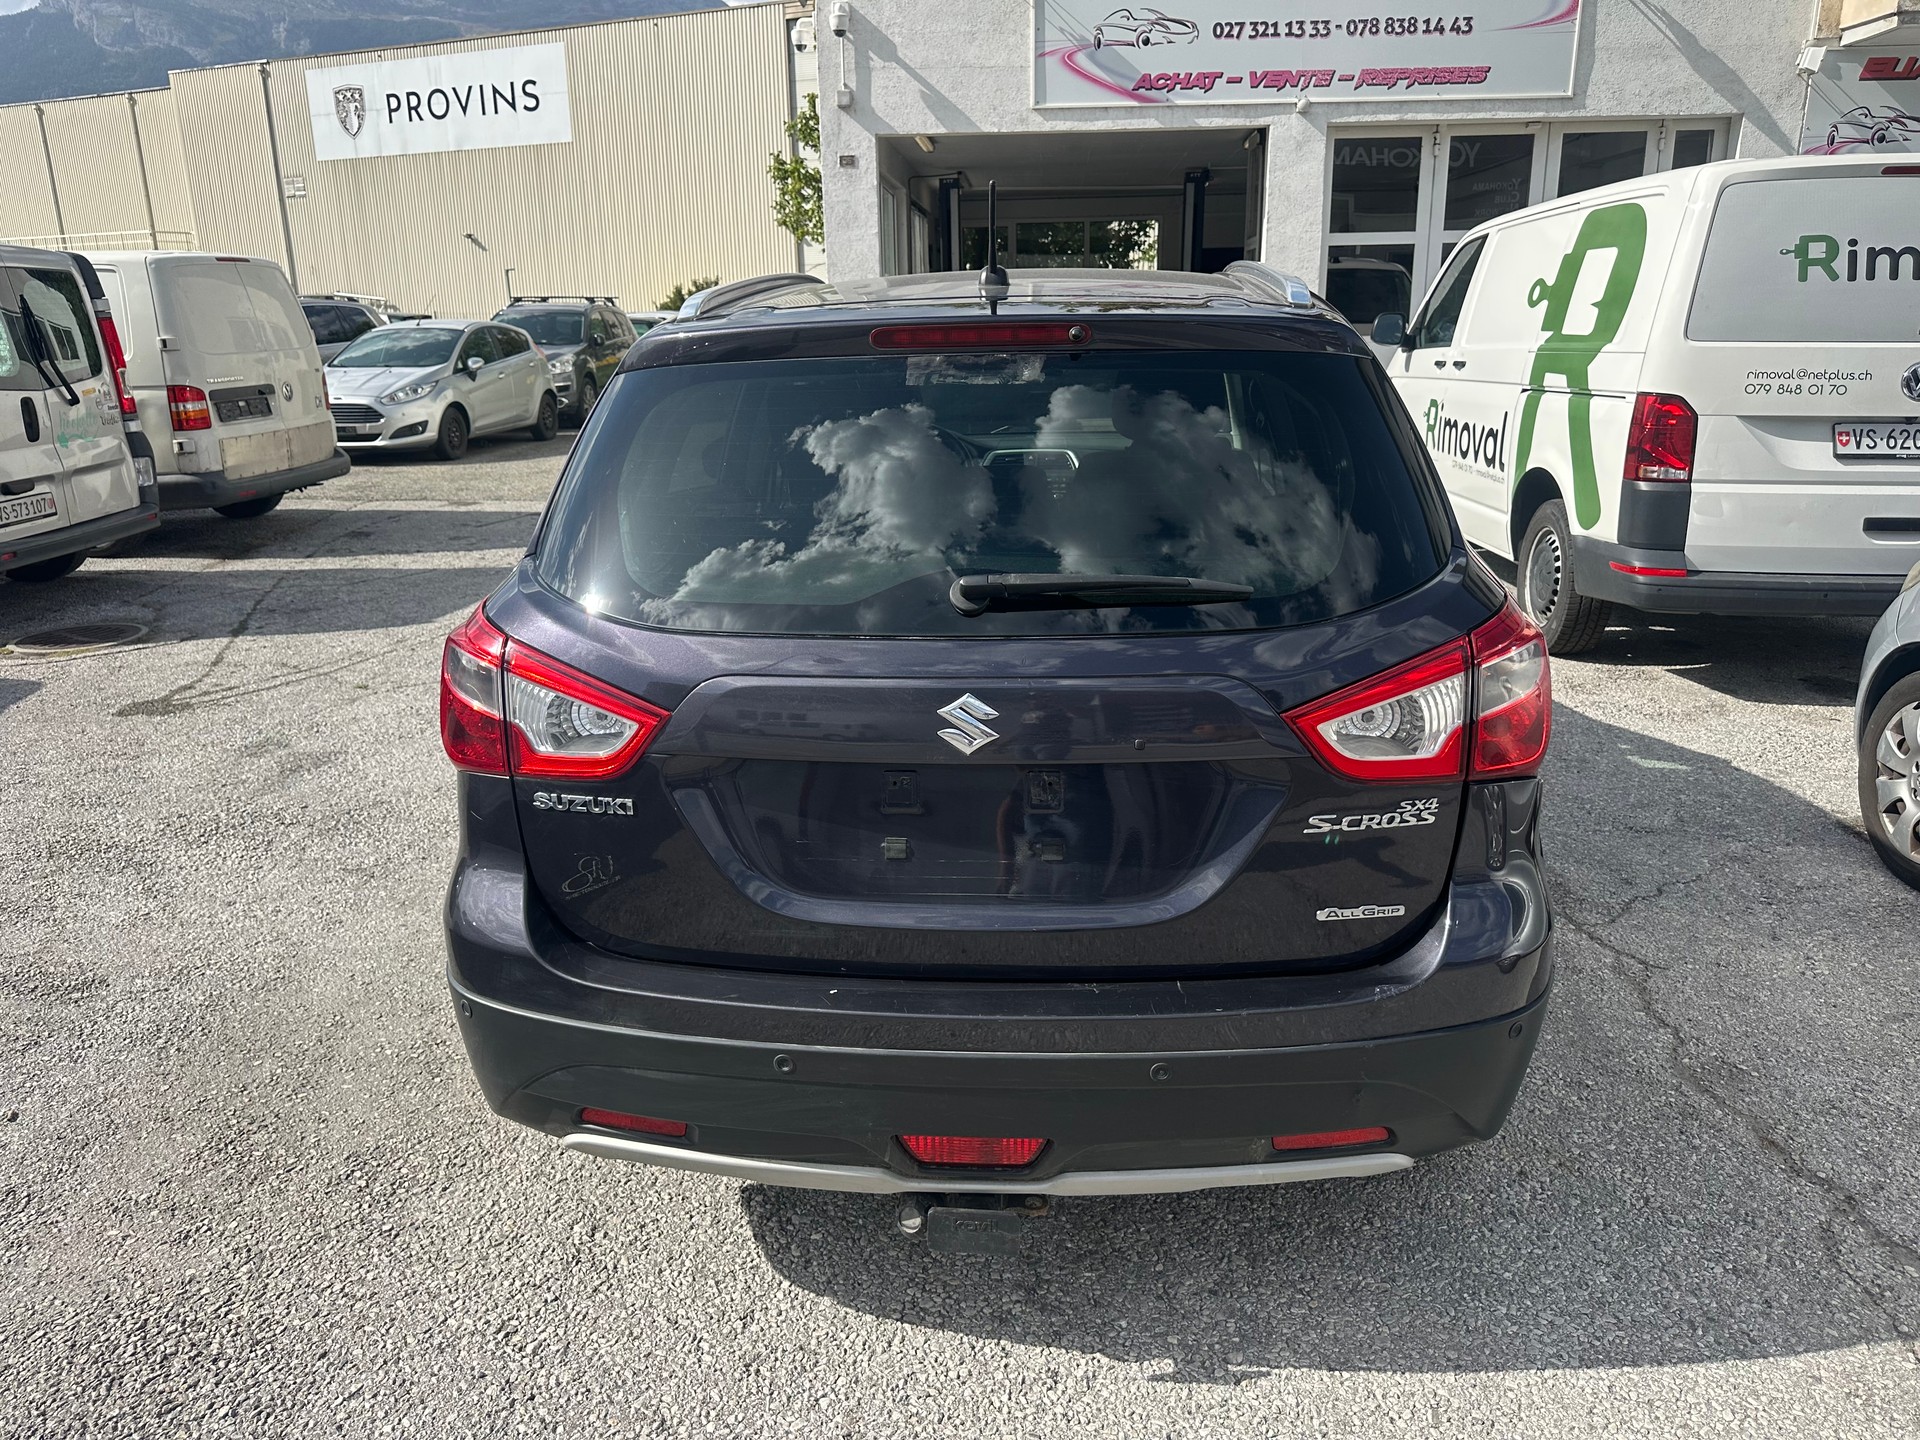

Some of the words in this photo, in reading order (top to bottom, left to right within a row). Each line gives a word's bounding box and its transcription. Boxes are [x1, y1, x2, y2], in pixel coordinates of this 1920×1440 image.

[1213, 21, 1245, 39] 027
[1248, 20, 1280, 39] 321
[1285, 20, 1306, 38] 13
[1309, 19, 1331, 38] 33
[1346, 17, 1380, 37] 078
[1384, 16, 1418, 36] 838
[1422, 17, 1445, 36] 14
[1449, 16, 1473, 35] 43
[1131, 72, 1224, 94] ACHAT
[1249, 69, 1336, 92] VENTE
[1354, 65, 1492, 91] REPRISES
[386, 79, 540, 124] PROVINS
[1746, 368, 1873, 382] rimoval@netplus.ch
[1744, 383, 1772, 395] 079
[1776, 383, 1803, 395] 848
[1808, 384, 1824, 396] 01
[1828, 384, 1848, 396] 70
[1425, 398, 1508, 473] Rimoval
[533, 792, 634, 815] SUZUKI
[1397, 797, 1440, 812] SX4
[1303, 809, 1439, 834] S-CROSS
[1324, 907, 1401, 919] ALLGRIP
